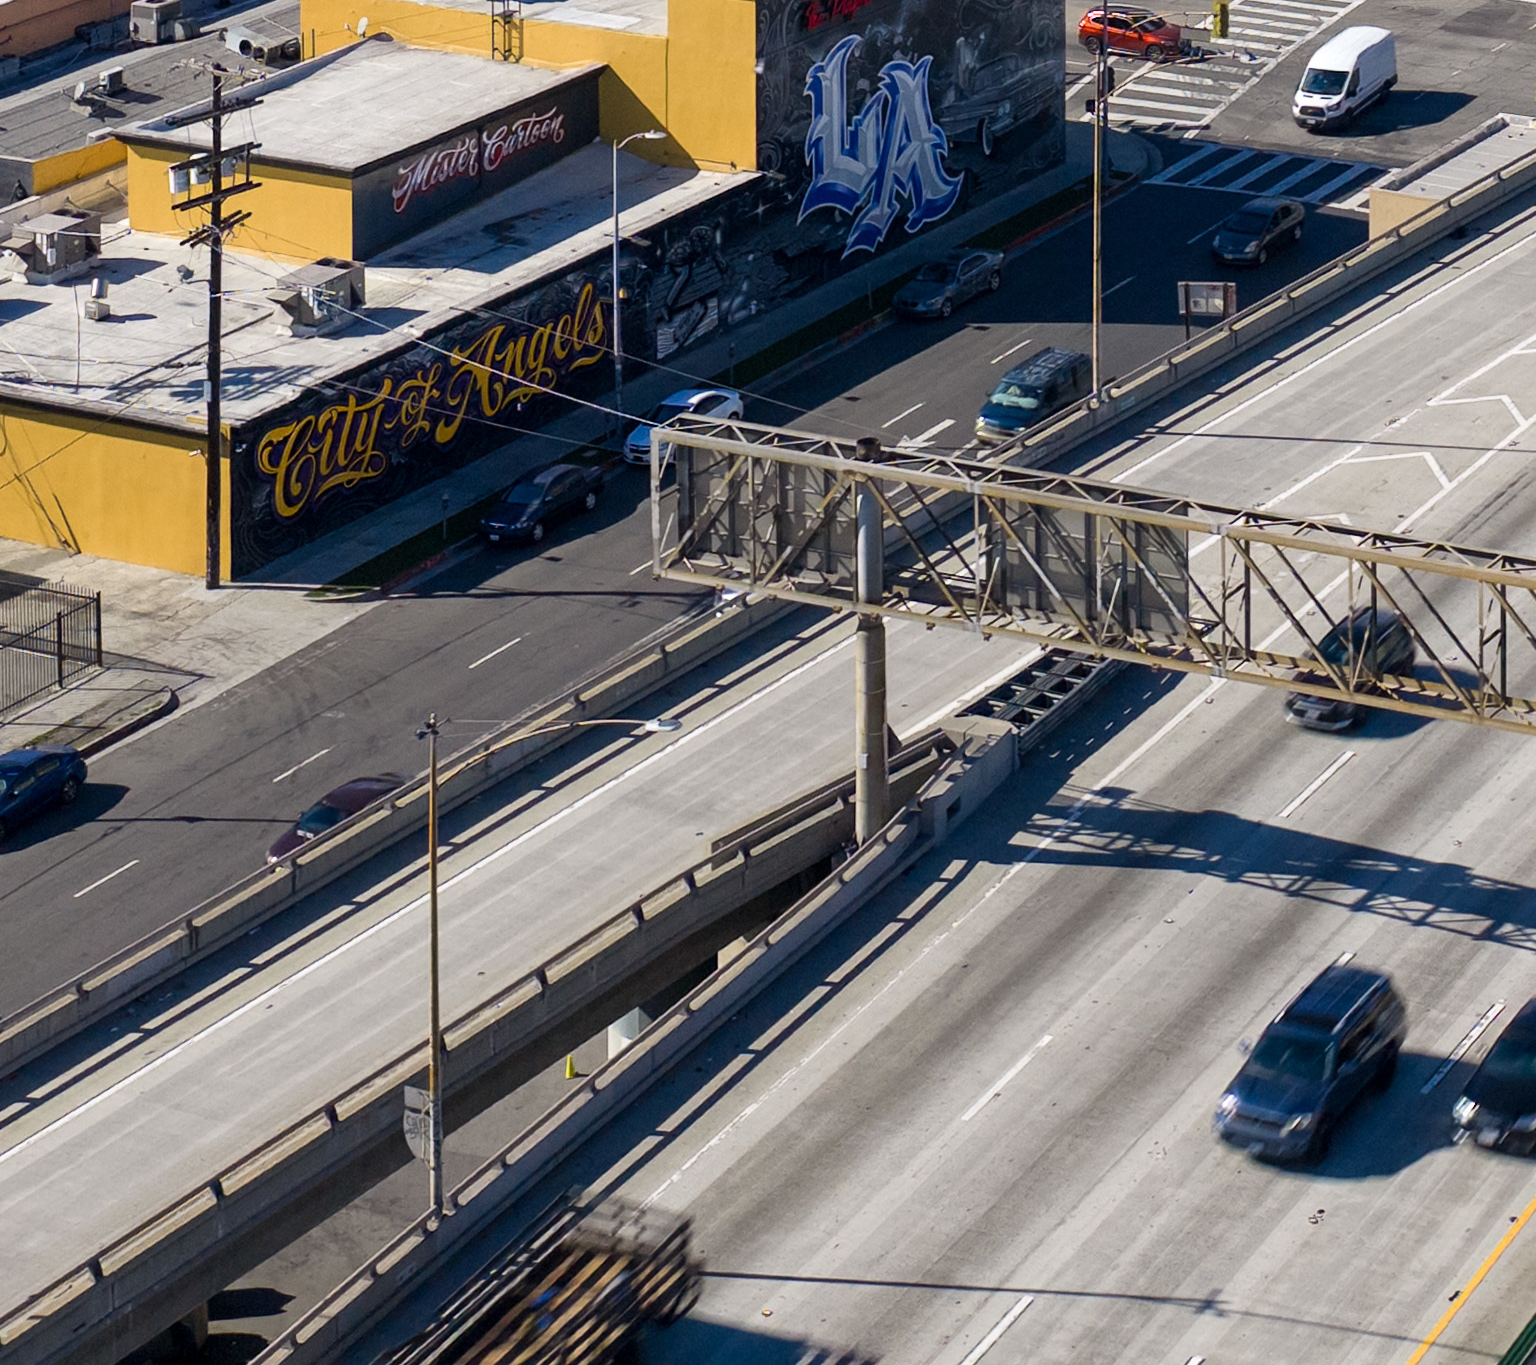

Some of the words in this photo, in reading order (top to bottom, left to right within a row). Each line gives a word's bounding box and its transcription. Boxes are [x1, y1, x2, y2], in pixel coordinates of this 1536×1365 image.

[392, 138, 479, 213] Mister
[482, 105, 564, 172] Cartoon
[796, 33, 966, 260] LA
[258, 378, 393, 518] City
[384, 363, 443, 446] of
[435, 283, 607, 444] Angels
